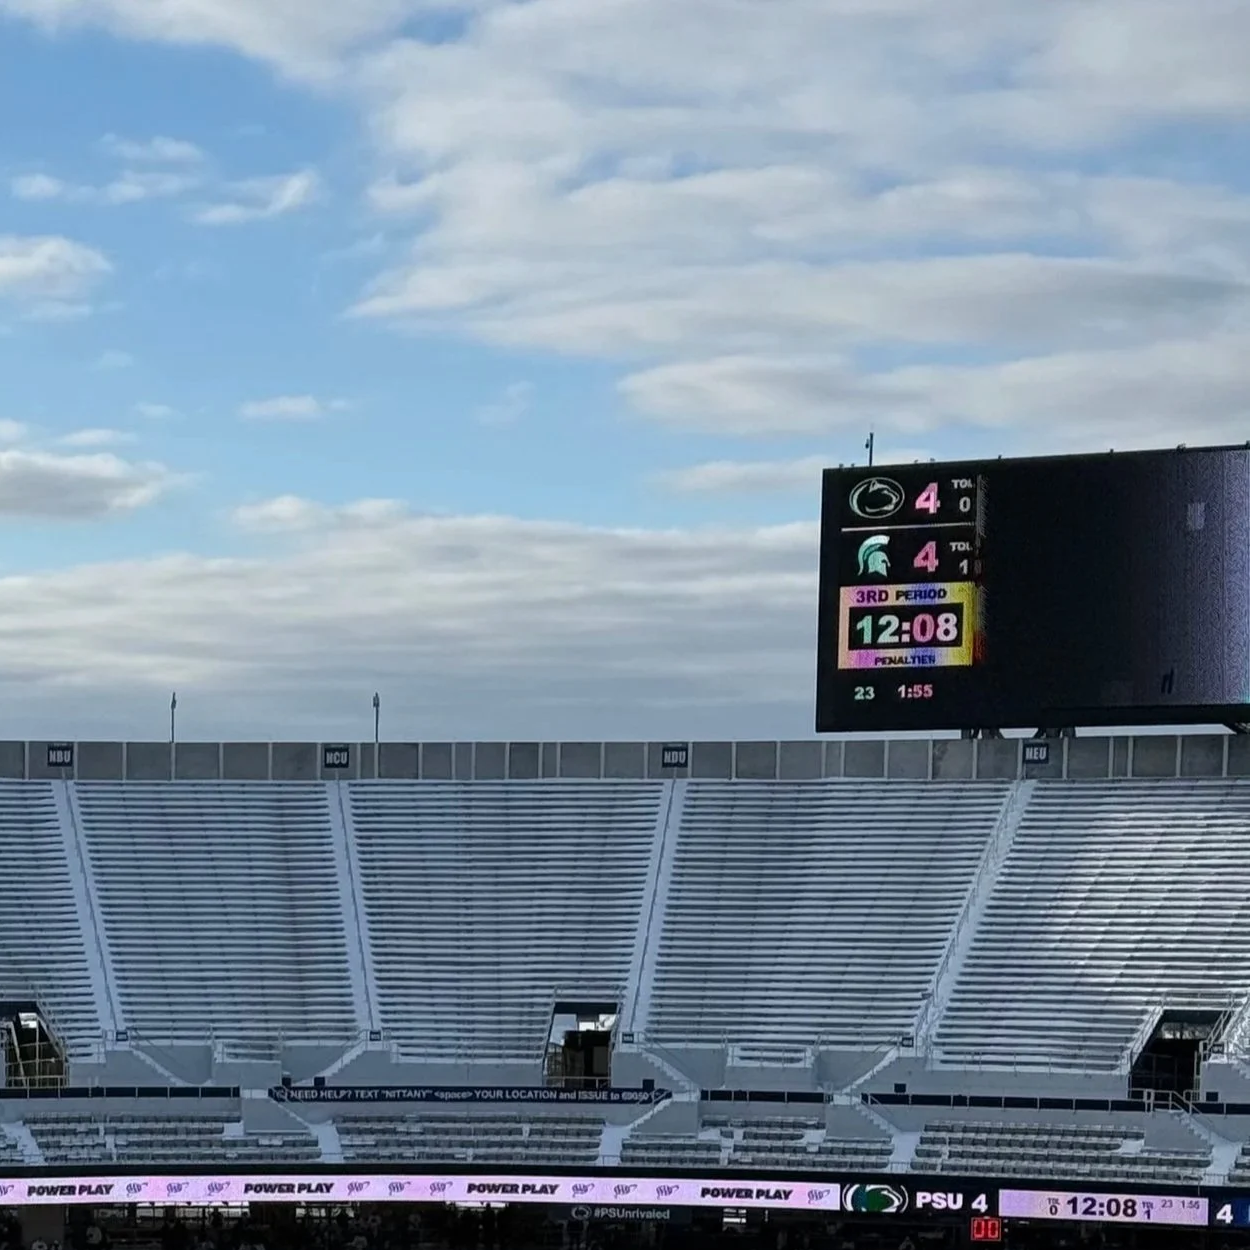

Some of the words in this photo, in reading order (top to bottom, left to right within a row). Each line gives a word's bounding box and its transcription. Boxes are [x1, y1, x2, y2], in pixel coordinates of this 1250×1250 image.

[915, 482, 940, 514] 4
[959, 497, 971, 512] 0
[913, 541, 939, 572] 4
[856, 590, 889, 603] 3RD
[896, 588, 947, 601] PERIOD
[856, 613, 958, 644] 12:08
[854, 686, 875, 700] 23
[897, 684, 933, 698] 1:55
[355, 1088, 379, 1099] TEXT
[474, 1090, 503, 1099] YOUR
[506, 1089, 557, 1099] LOCATION
[559, 1090, 576, 1100] and
[578, 1090, 607, 1100] ISSUE
[27, 1184, 77, 1197] POWER
[78, 1183, 114, 1196] PLAY
[244, 1183, 295, 1194] POWER
[297, 1183, 334, 1194] PLAY
[467, 1183, 519, 1194] POWER
[521, 1183, 559, 1195] PLAY
[701, 1188, 754, 1199] POWER
[755, 1188, 793, 1200] PLAY
[916, 1191, 963, 1209] PSU
[971, 1194, 988, 1212] 4
[1067, 1196, 1137, 1217] 12:08
[594, 1208, 670, 1219] #PSUnrivaled
[1216, 1204, 1233, 1224] 4
